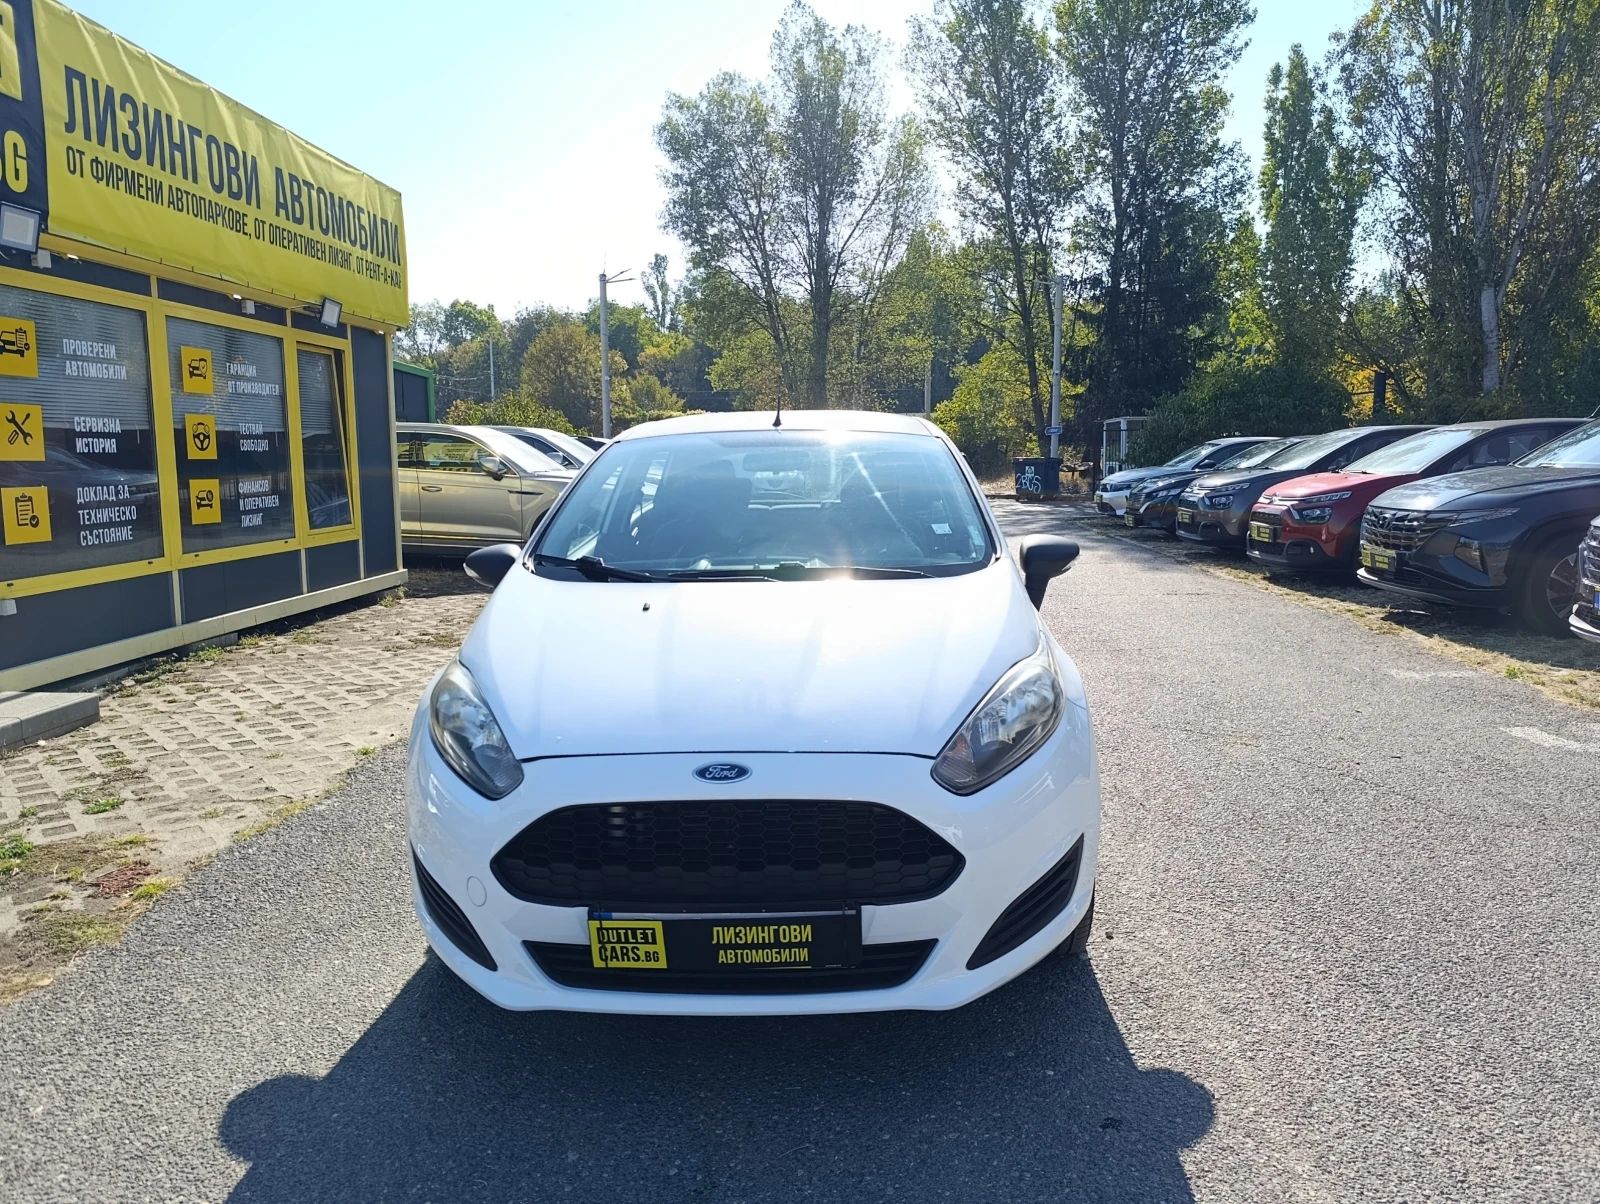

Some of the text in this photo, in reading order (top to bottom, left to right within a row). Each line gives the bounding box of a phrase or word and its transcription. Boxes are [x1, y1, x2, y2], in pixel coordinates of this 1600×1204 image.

[64, 64, 401, 267] ЛИЗИНГОВИ АВТОМОБИЛИ
[66, 145, 86, 179] ОТ
[90, 156, 164, 207] ФИРМЕНИ
[167, 184, 252, 240] АВТОПАРКОВЕ,
[254, 217, 267, 242] ОТ
[268, 222, 326, 263] ОПЕРАТИВЕН
[356, 255, 365, 276] ОТ
[63, 338, 117, 359] ПРОВЕРЕНИ
[65, 360, 127, 380] АВТОМОБИЛИ
[226, 362, 257, 378] ГАРАНЦИЯ
[227, 380, 235, 393] ОТ
[74, 416, 121, 433] СЕРВИЗНА
[239, 421, 264, 435] ТЕСТВАЙ
[75, 437, 117, 453] ИСТОРИЯ
[240, 439, 269, 452] СВОБОДНО
[77, 484, 130, 504] ДОКЛАД ЗА
[238, 479, 270, 494] ФИНАНСОВ
[239, 495, 280, 511] И ОПЕРАТИВЕН
[78, 505, 137, 525] ТЕХНИЧЕСКО
[80, 526, 133, 546] СЪСТОЯНИЕ
[705, 765, 739, 779] Ford
[599, 929, 654, 943] OUTLET
[711, 924, 813, 945] ЛИЗИНГОВИ
[598, 945, 660, 963] CARS.BG
[717, 948, 810, 964] АВТОМОБИЛИ
